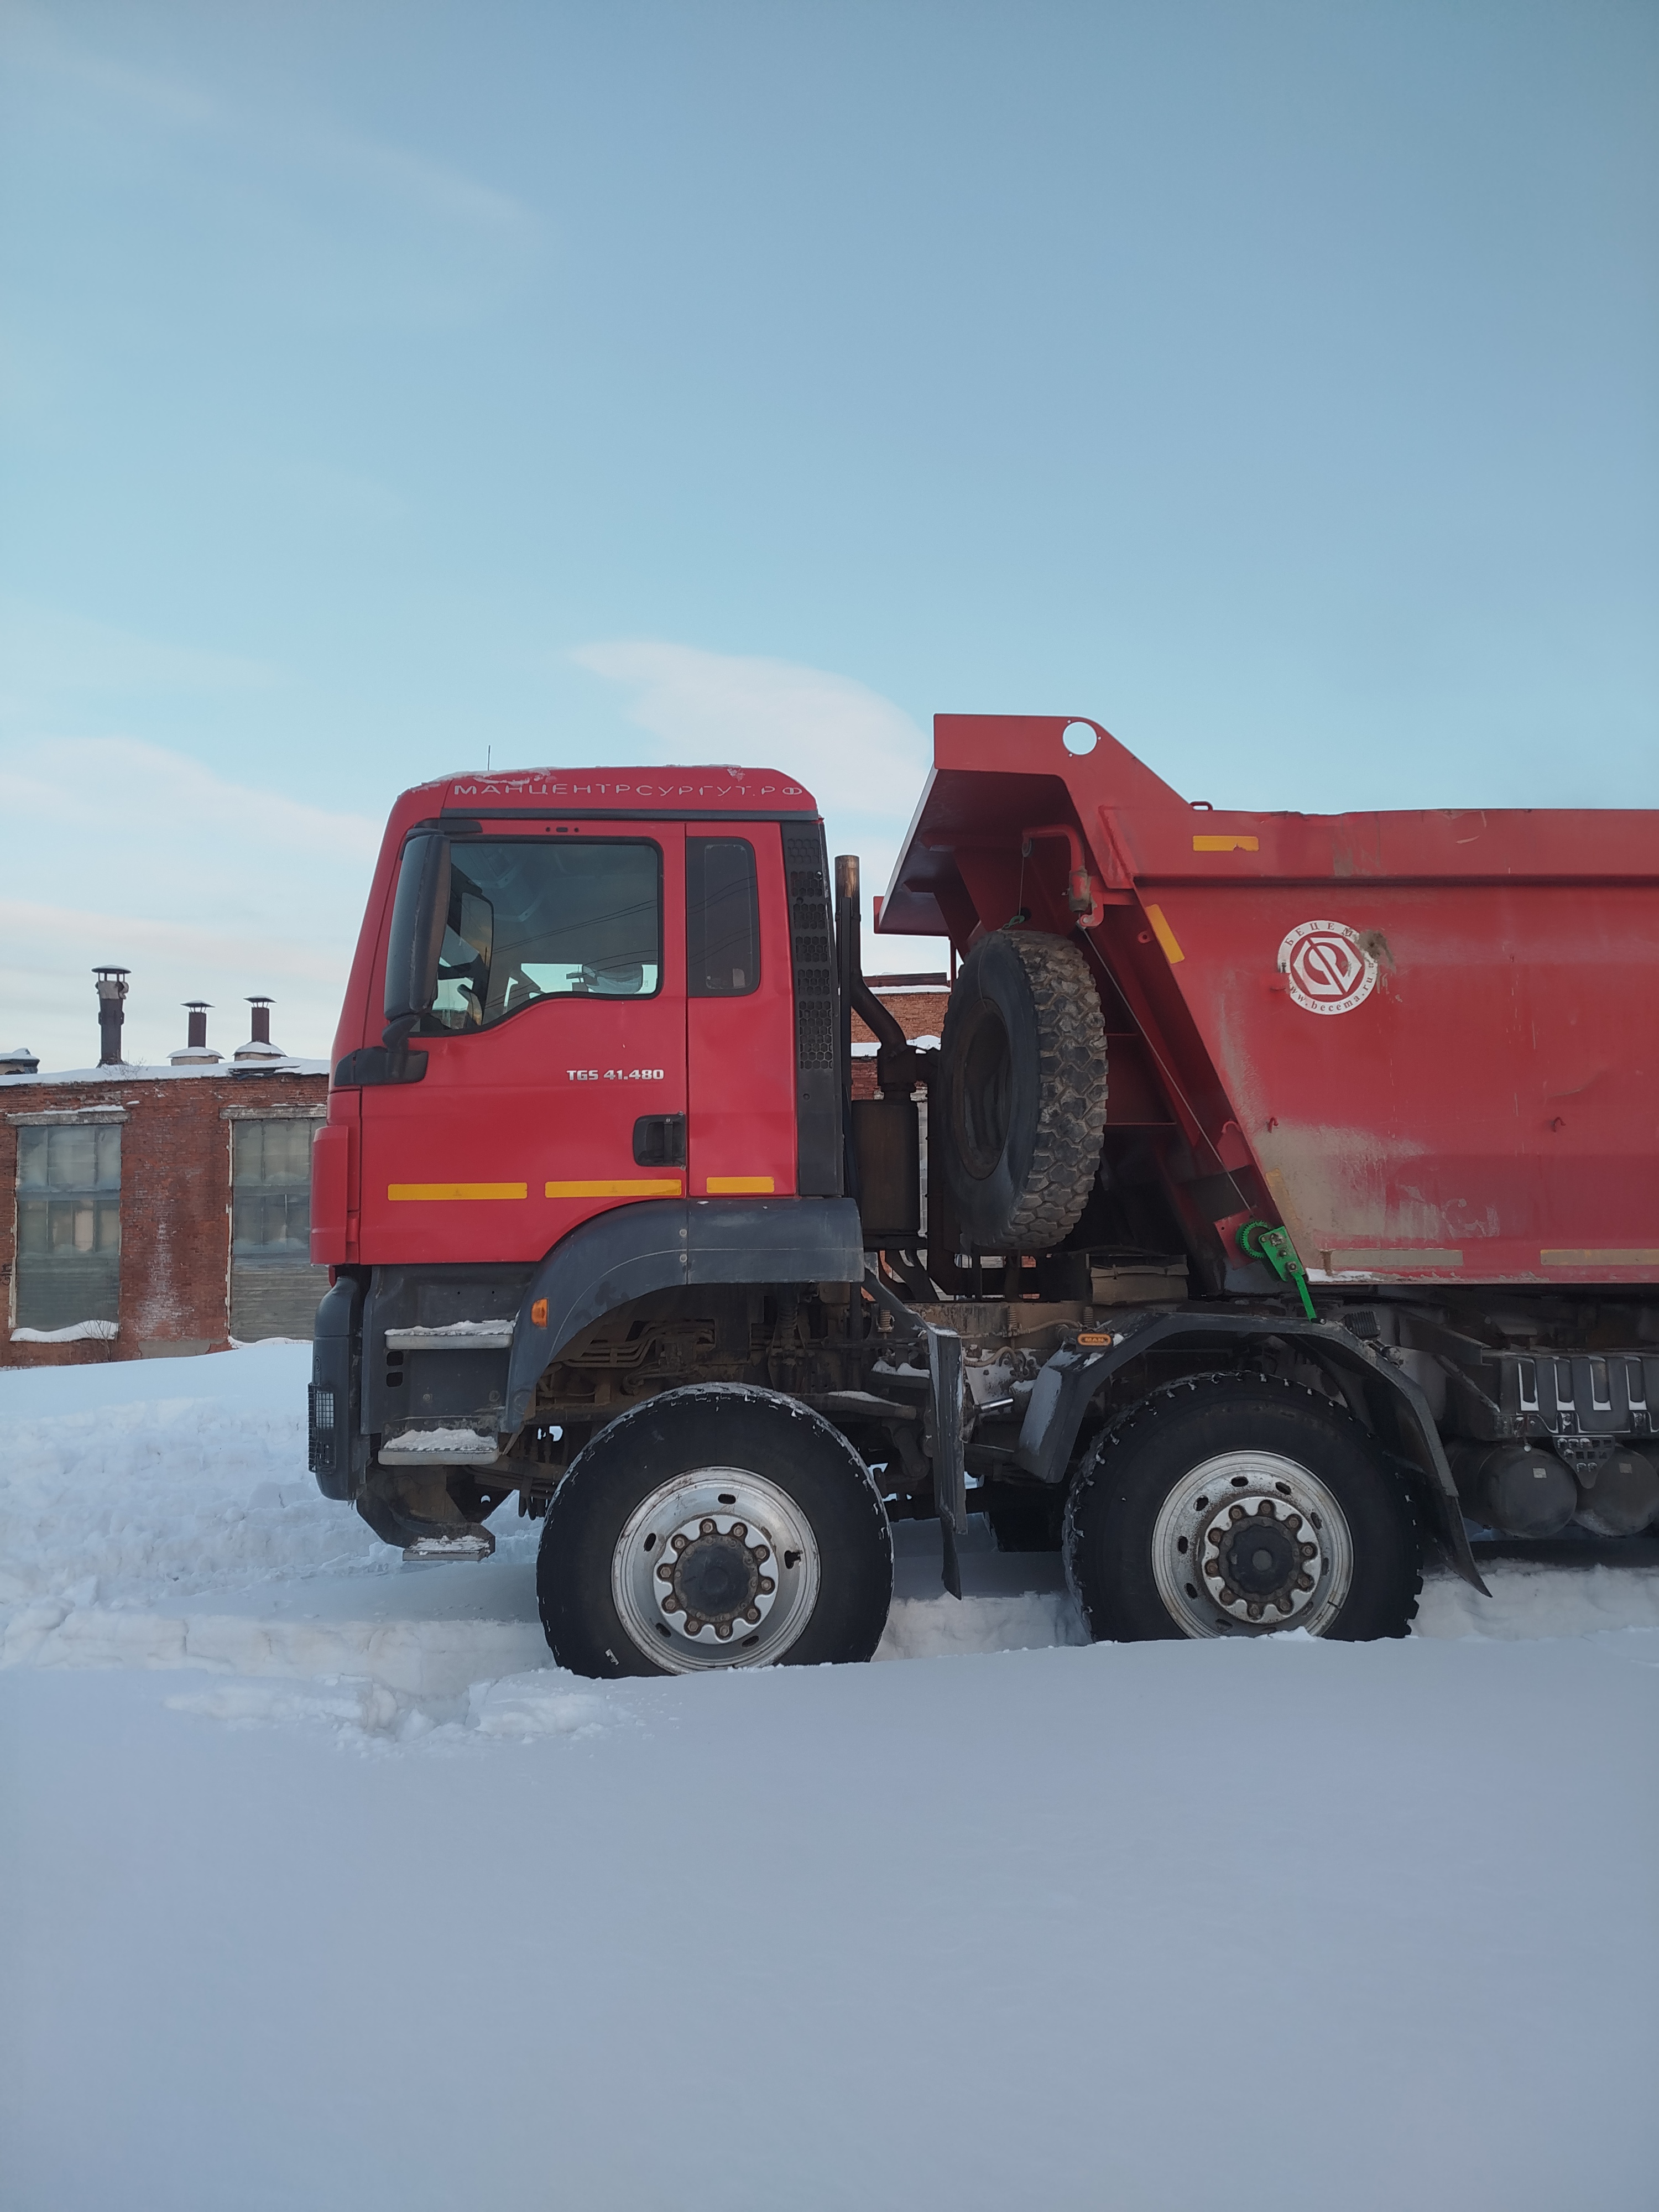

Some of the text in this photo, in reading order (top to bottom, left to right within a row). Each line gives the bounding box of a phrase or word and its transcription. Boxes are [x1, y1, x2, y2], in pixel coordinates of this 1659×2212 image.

[454, 784, 803, 796] МАНЦЕНТРСУРГУТ.РФ
[1284, 922, 1365, 947] БЕЦЕМ
[1288, 977, 1374, 1012] ww.becema.ru
[566, 1070, 664, 1081] TGS 41.480
